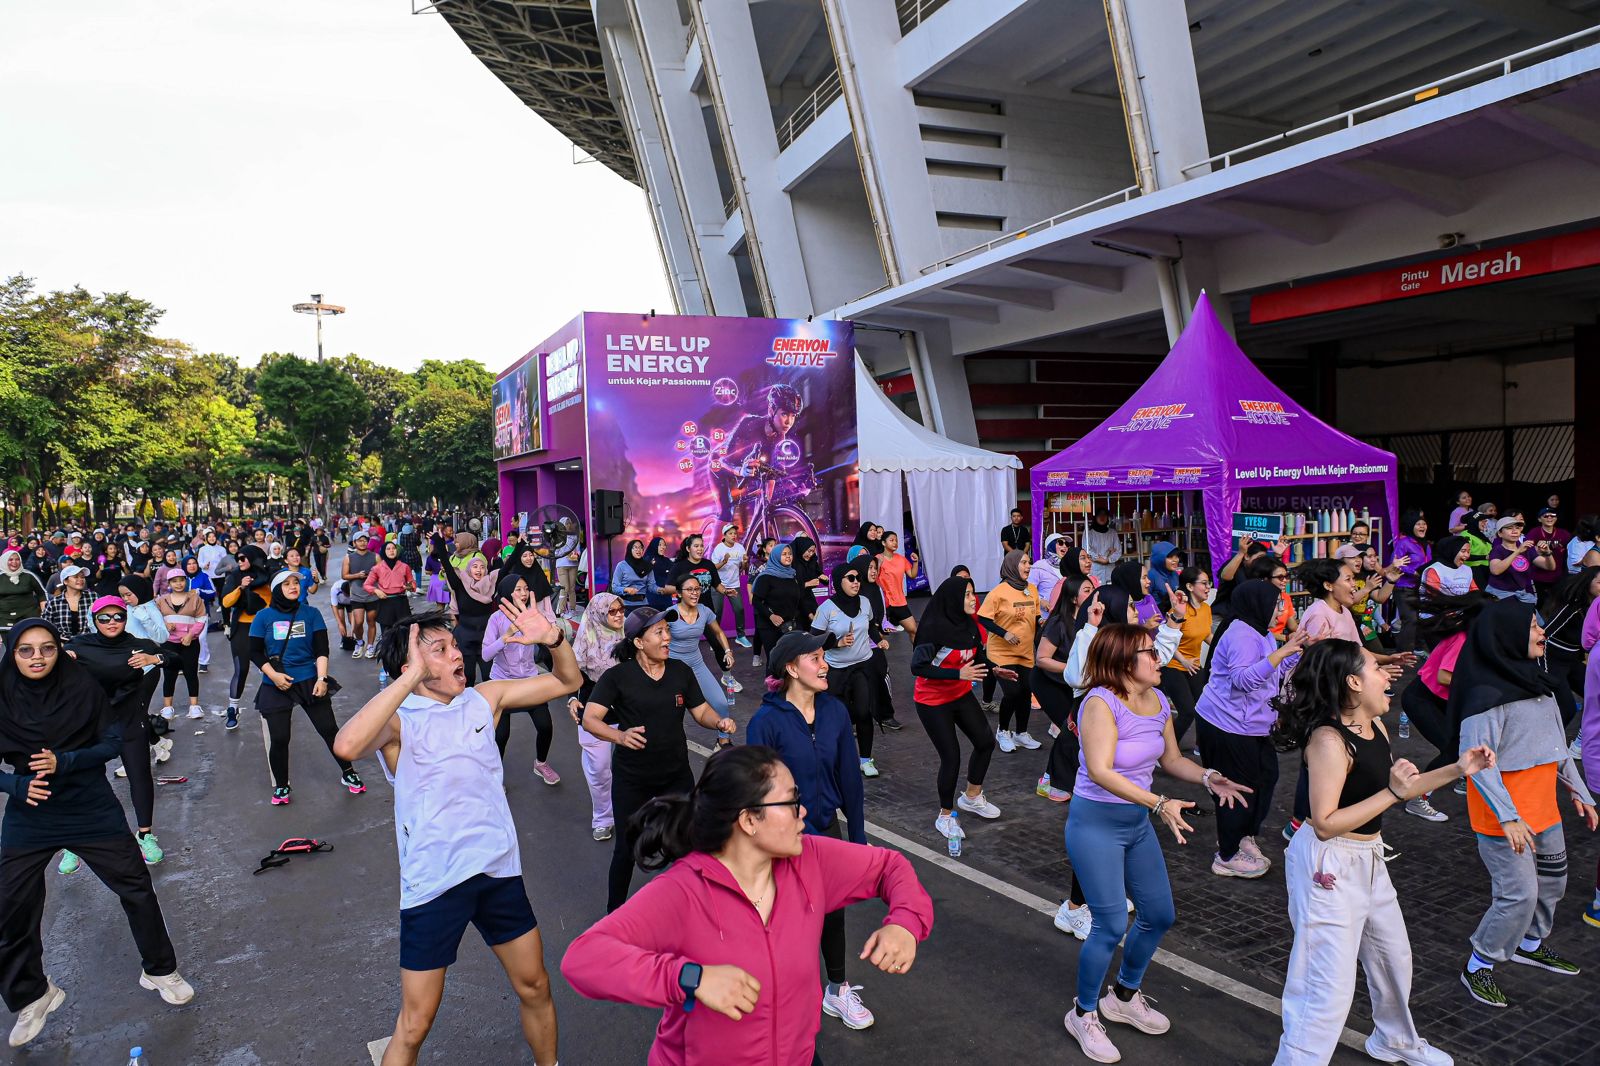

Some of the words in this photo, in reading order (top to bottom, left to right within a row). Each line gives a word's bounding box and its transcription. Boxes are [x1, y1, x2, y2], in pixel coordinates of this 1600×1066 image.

[1441, 251, 1521, 284] Merah
[1401, 270, 1429, 282] Pintu
[1401, 282, 1420, 292] Gate
[606, 334, 677, 352] LEVEL
[681, 336, 711, 352] UP
[773, 338, 830, 352] ENERVON
[607, 354, 710, 374] ENERGY
[770, 352, 832, 366] ACTIVE
[608, 377, 635, 385] untuk
[636, 377, 661, 387] Kejar
[662, 378, 711, 386] Passionmu
[715, 386, 736, 396] Zinc
[1131, 403, 1187, 420] ENERVON
[1239, 400, 1285, 413] ENERVON
[1113, 415, 1184, 432] ACTIVE
[1237, 411, 1295, 425] ACTIVE
[684, 424, 696, 434] B5
[714, 431, 724, 440] B1
[781, 441, 792, 455] C
[680, 460, 693, 470] B12
[1235, 467, 1257, 479] Level
[1260, 466, 1272, 480] Up
[1274, 466, 1301, 480] Energy
[1303, 465, 1327, 476] Untuk
[1328, 464, 1348, 477] Kejar
[1350, 463, 1389, 474] Passionmu
[1267, 496, 1288, 510] UP
[1291, 495, 1354, 510] ENERGY
[1244, 516, 1267, 528] TYESO
